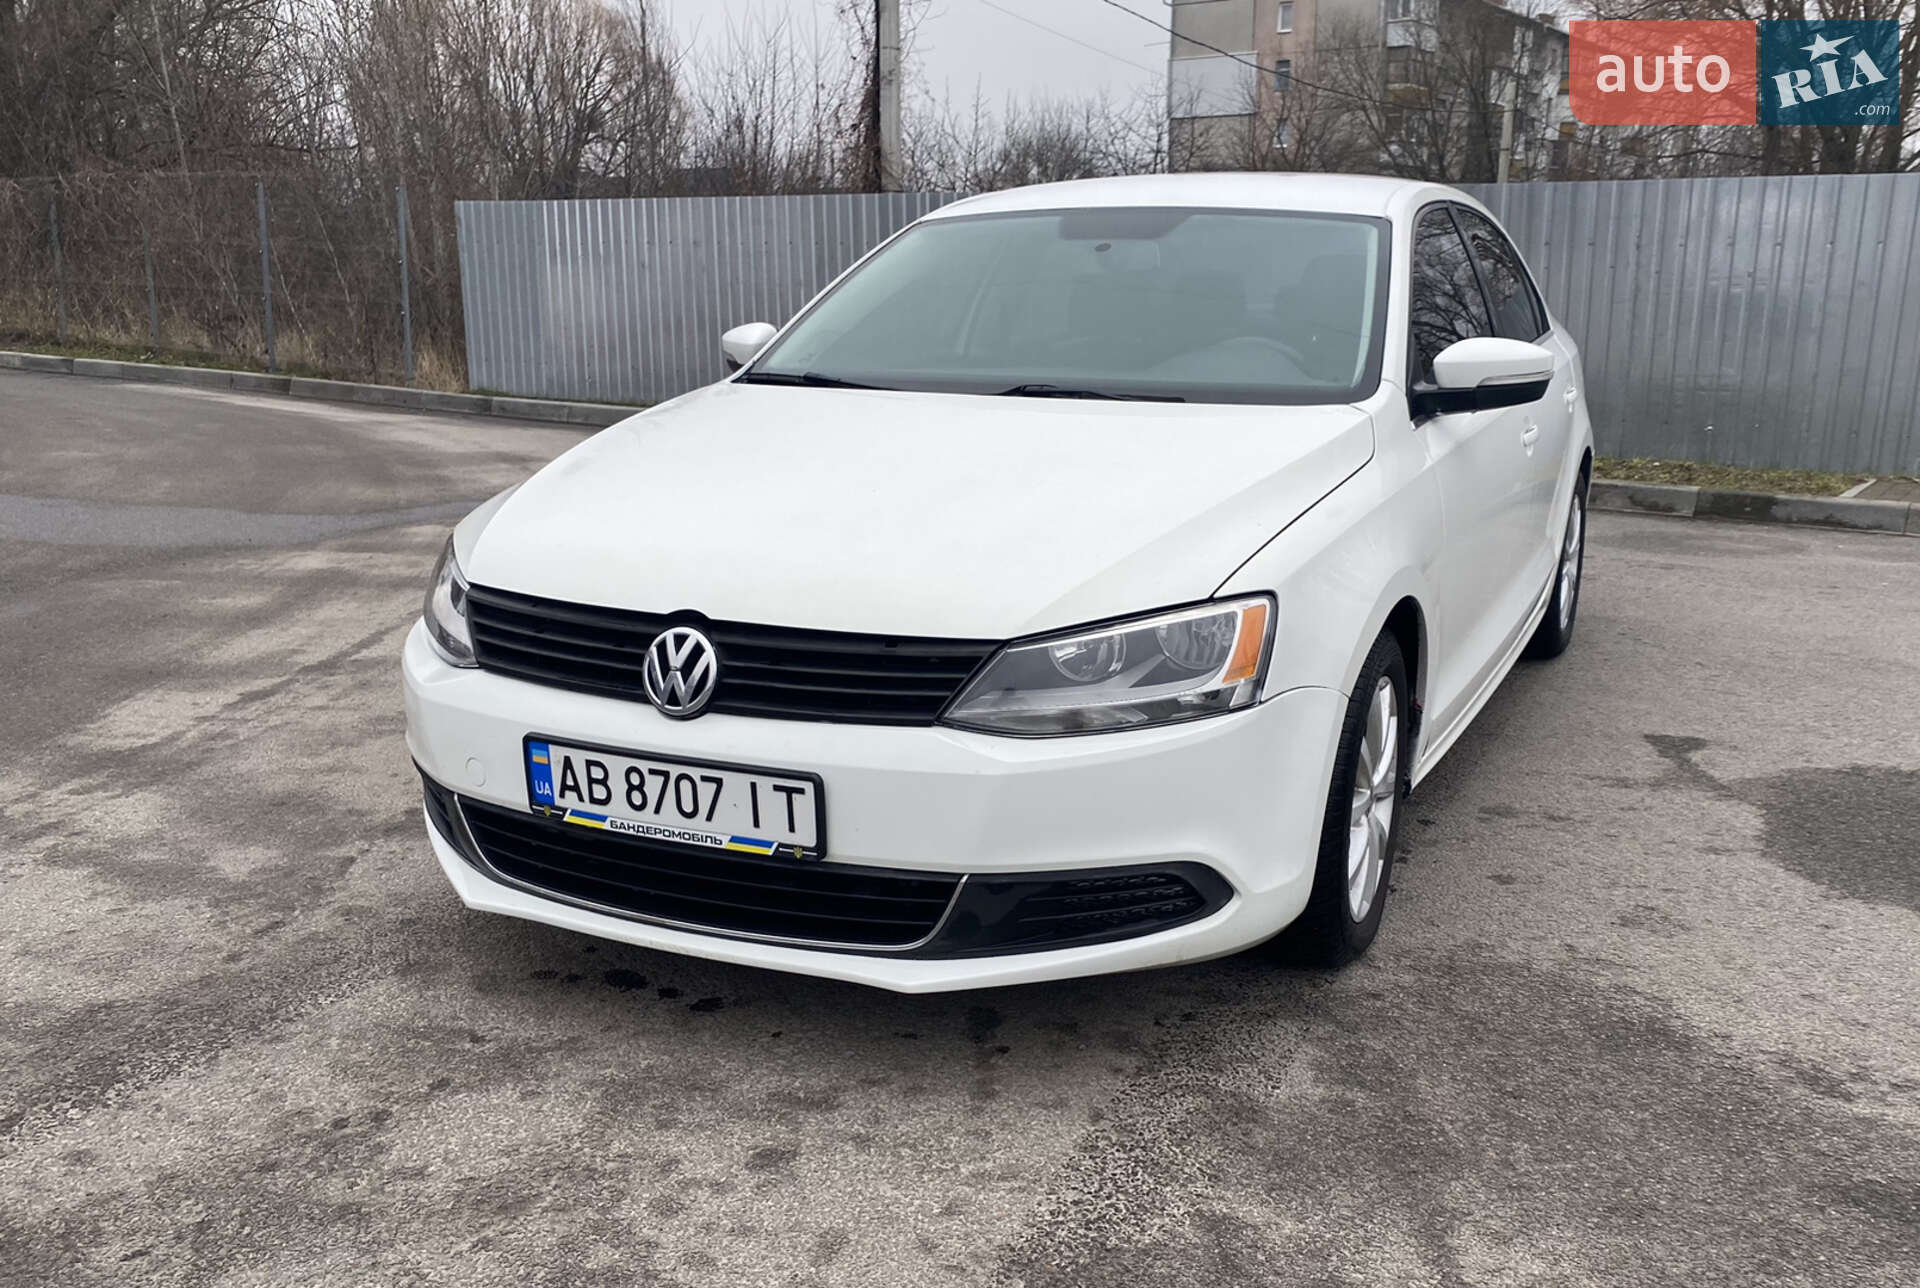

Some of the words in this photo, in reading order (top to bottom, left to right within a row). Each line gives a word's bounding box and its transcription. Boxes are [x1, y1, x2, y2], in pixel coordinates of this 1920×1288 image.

[535, 780, 552, 797] UA
[558, 755, 612, 806] AB
[624, 765, 723, 822] 8707
[749, 781, 805, 833] IT
[609, 819, 724, 846] БАНДЕРОМОБІЛЬ
